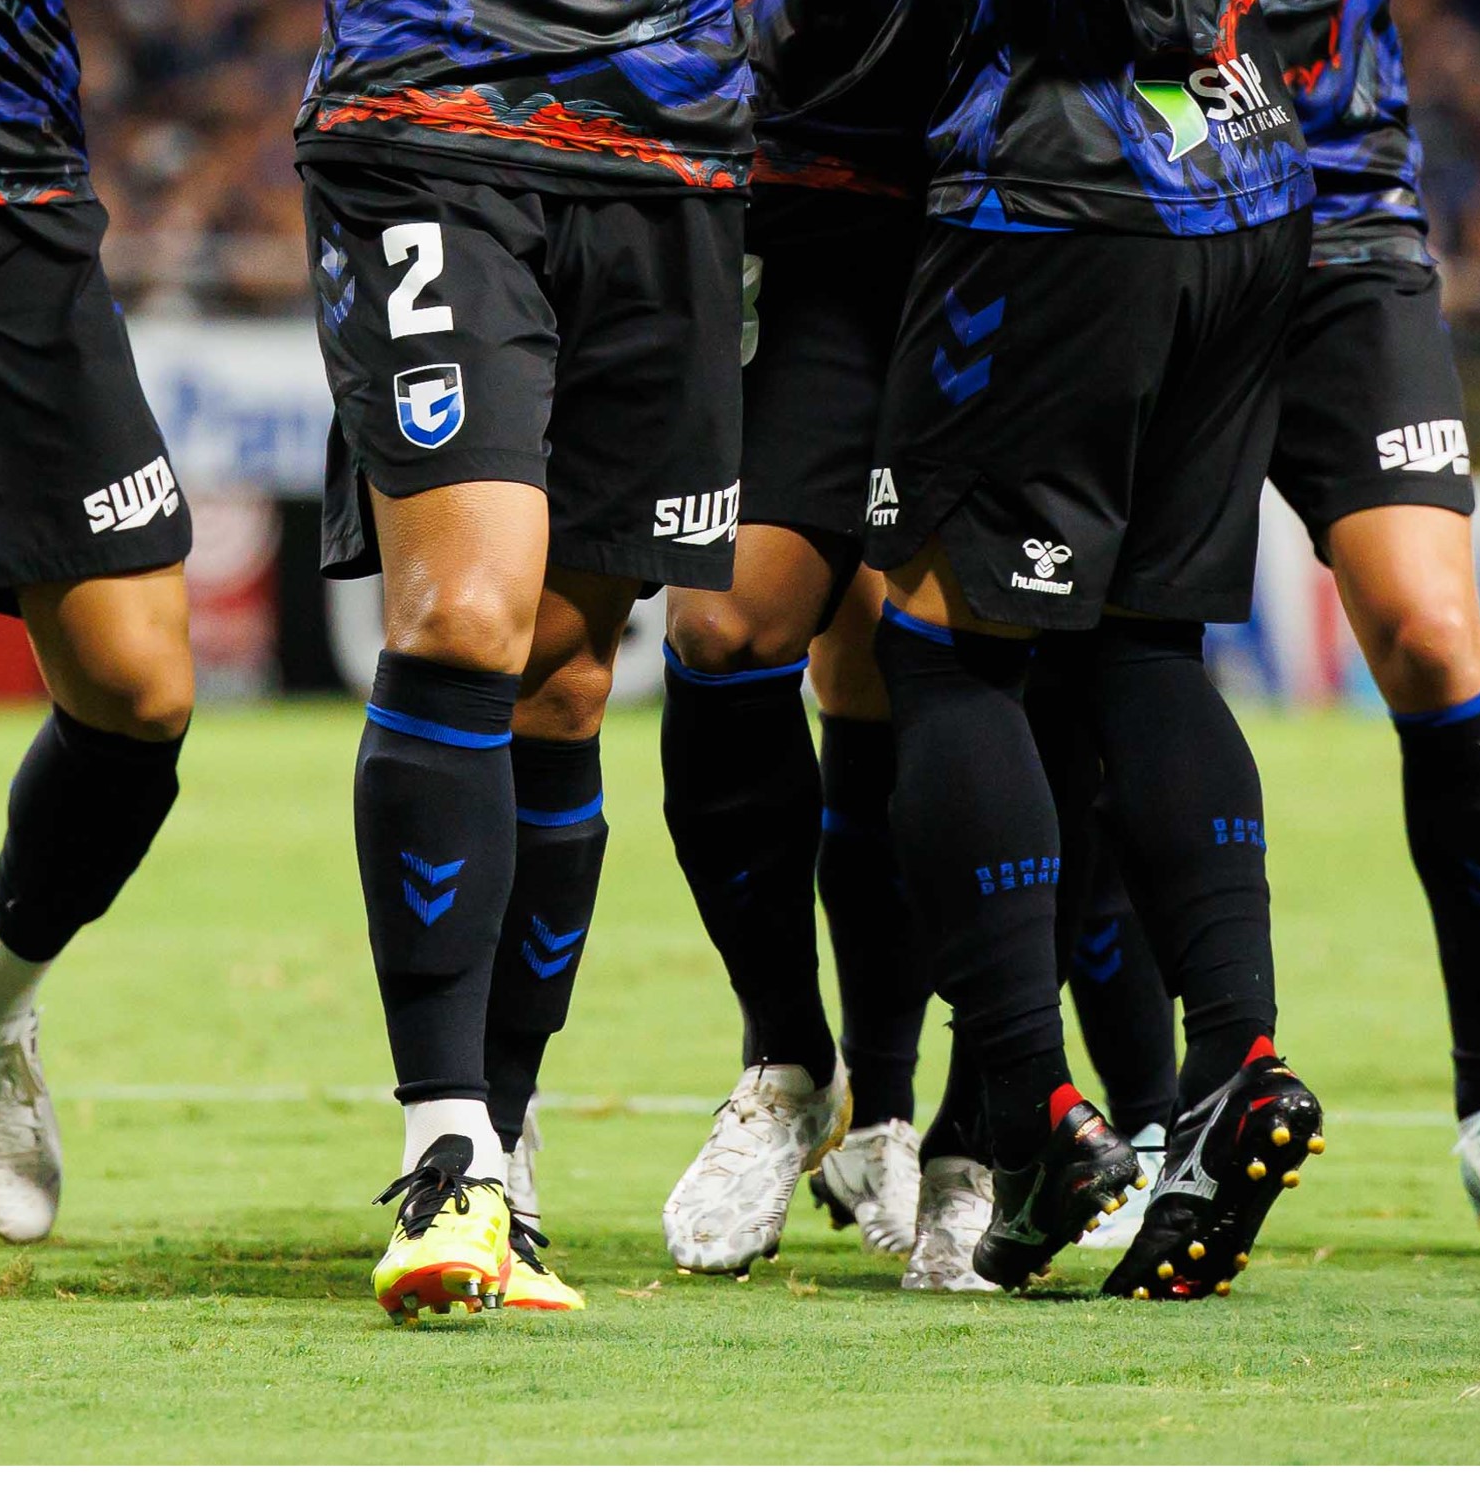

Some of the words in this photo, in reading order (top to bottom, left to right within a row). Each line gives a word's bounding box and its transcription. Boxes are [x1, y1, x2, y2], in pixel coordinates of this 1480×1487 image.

[381, 222, 454, 340] 2
[872, 508, 900, 527] CITY
[1011, 571, 1074, 595] hummel
